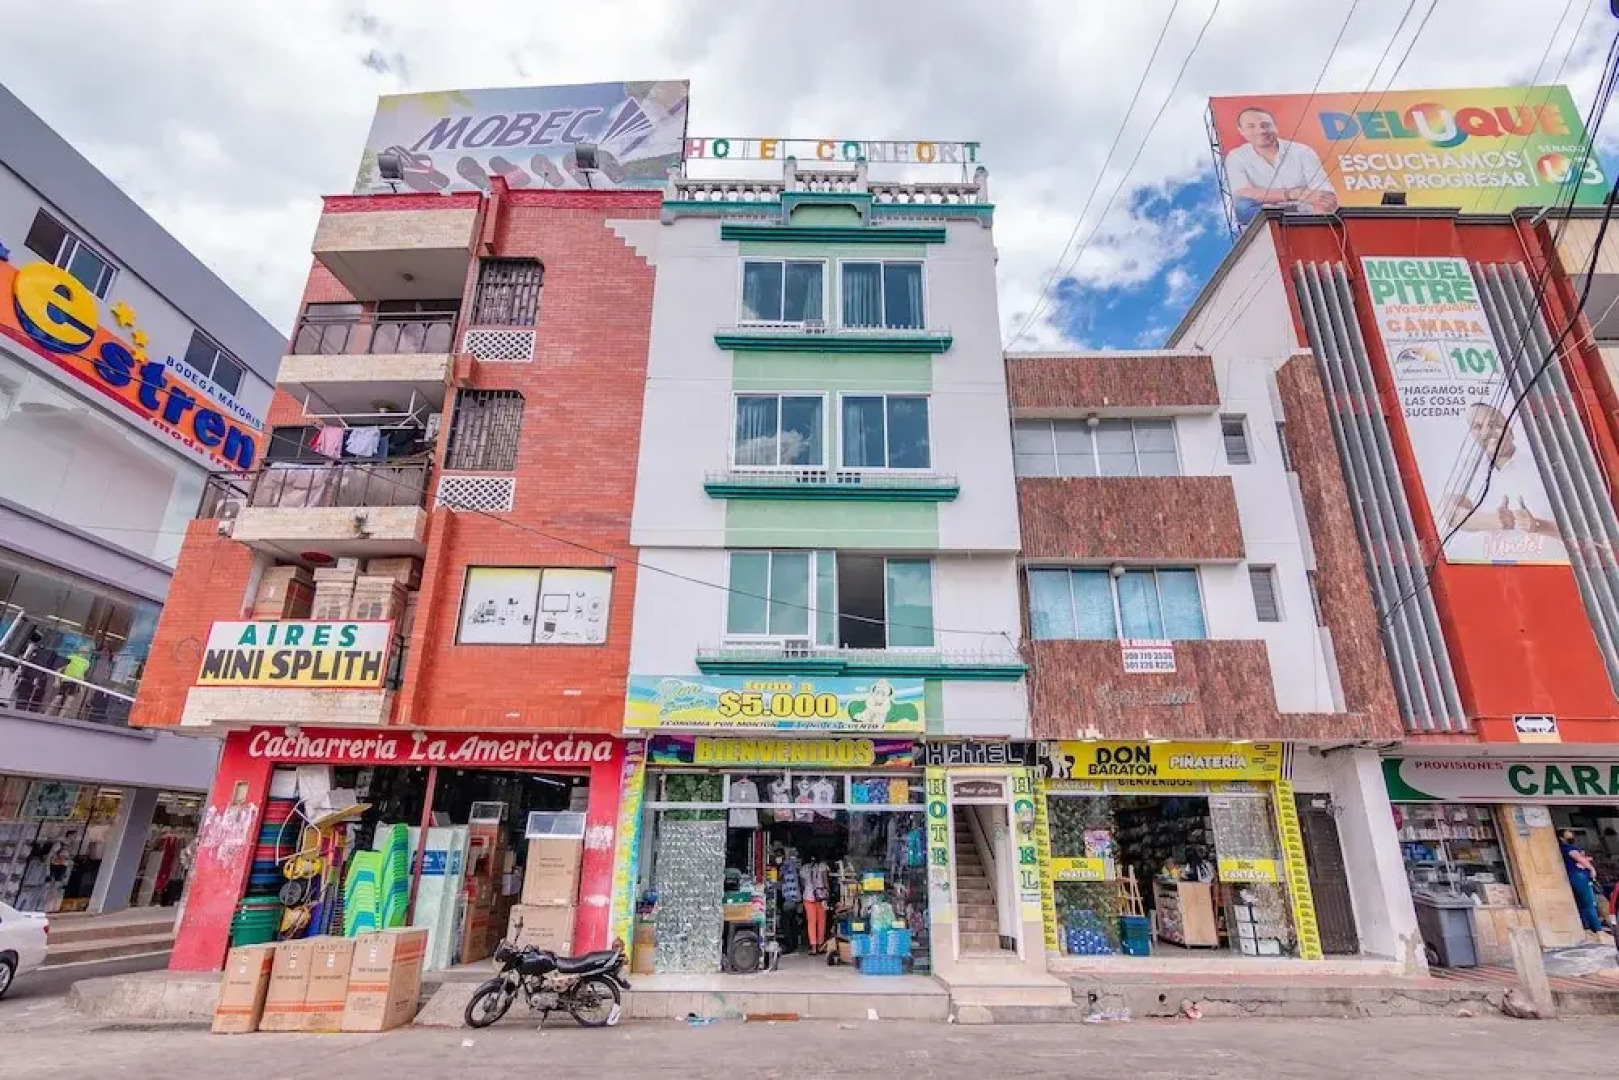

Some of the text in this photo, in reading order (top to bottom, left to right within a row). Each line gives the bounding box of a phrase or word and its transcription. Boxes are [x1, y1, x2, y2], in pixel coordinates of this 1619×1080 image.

[411, 106, 604, 152] MOBEC
[1318, 103, 1571, 147] DELUQUE
[1339, 150, 1523, 172] ESCUCHAMOS
[1344, 173, 1529, 192] PARA PROGRESAR
[1365, 260, 1471, 281] MIGUEL
[1370, 279, 1478, 305] PITRE
[1450, 347, 1498, 374] 101
[166, 355, 216, 396] BODEGA
[1404, 396, 1466, 406] LAS COSAS
[1467, 386, 1491, 396] QUE
[237, 624, 359, 647] AIRES
[200, 648, 383, 681] MINI SPLITH
[718, 689, 838, 718] $5.000
[249, 729, 397, 761] Cacharreria
[409, 733, 446, 761] La
[699, 739, 875, 766] BIENVENIDOS
[1096, 745, 1151, 765] DON
[1414, 760, 1504, 770] PROVISIONES
